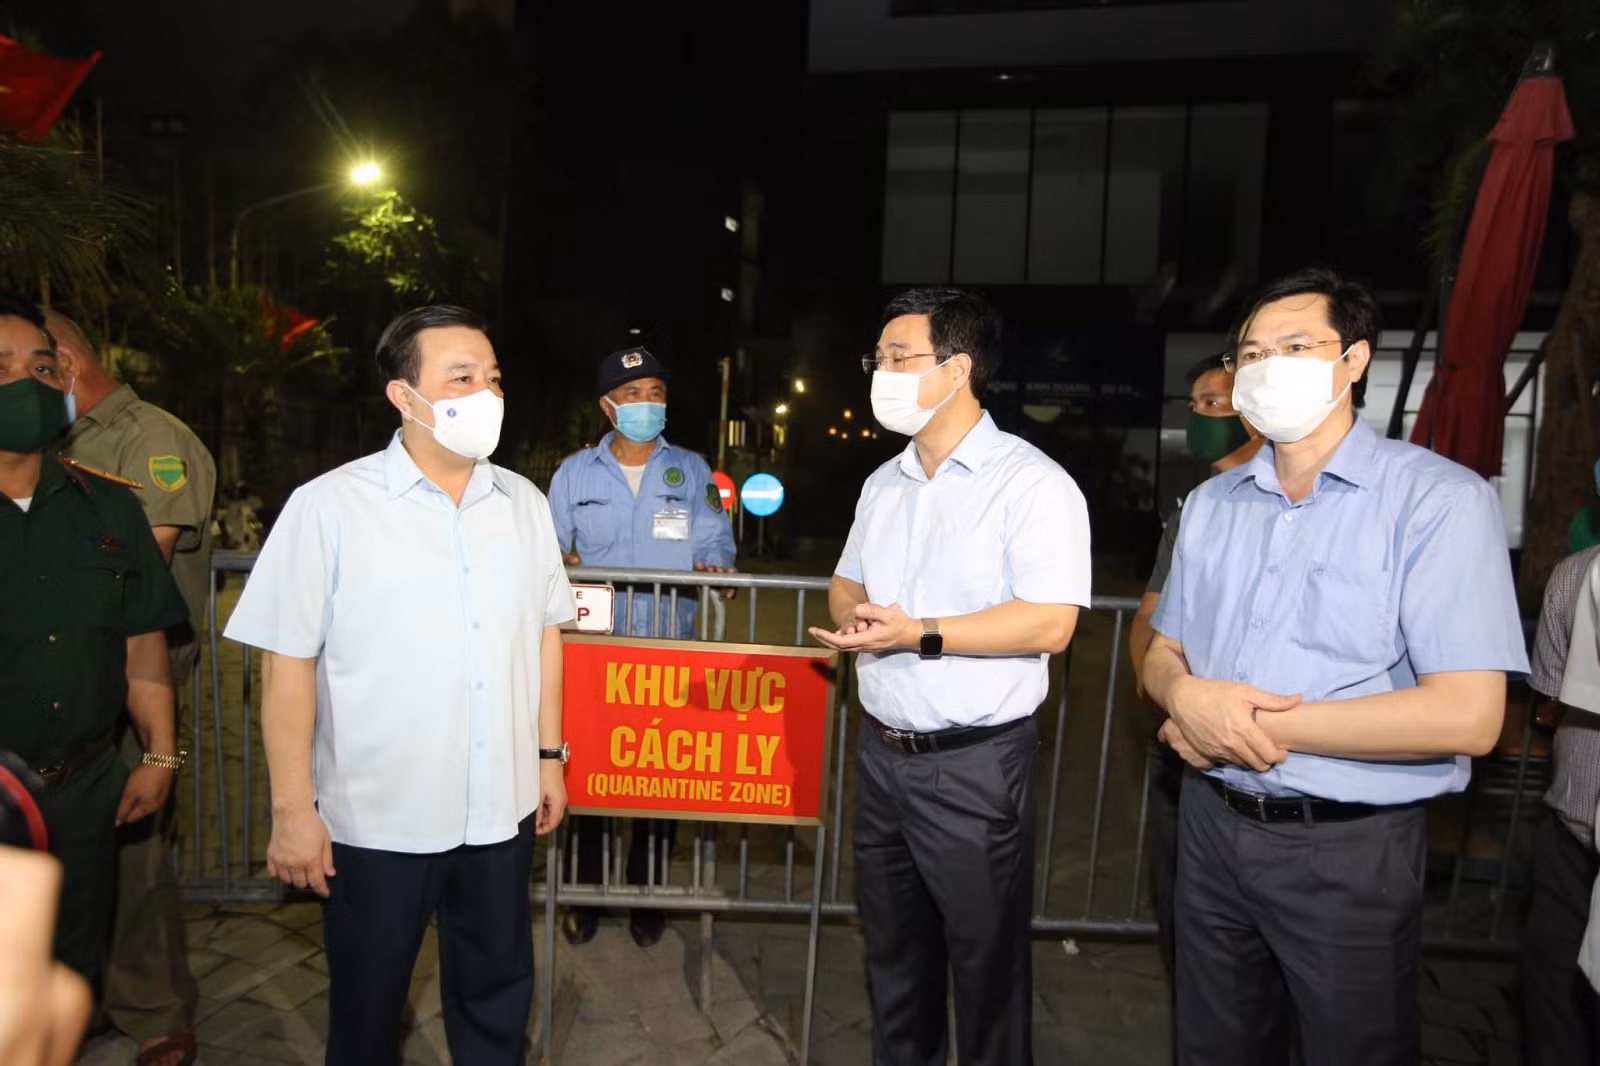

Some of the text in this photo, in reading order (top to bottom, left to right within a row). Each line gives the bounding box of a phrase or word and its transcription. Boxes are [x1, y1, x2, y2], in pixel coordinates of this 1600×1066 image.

[605, 661, 786, 721] KHU VỰC
[610, 718, 781, 776] CÁCH LY
[587, 773, 792, 807] (QUARANTINE ZONE)
